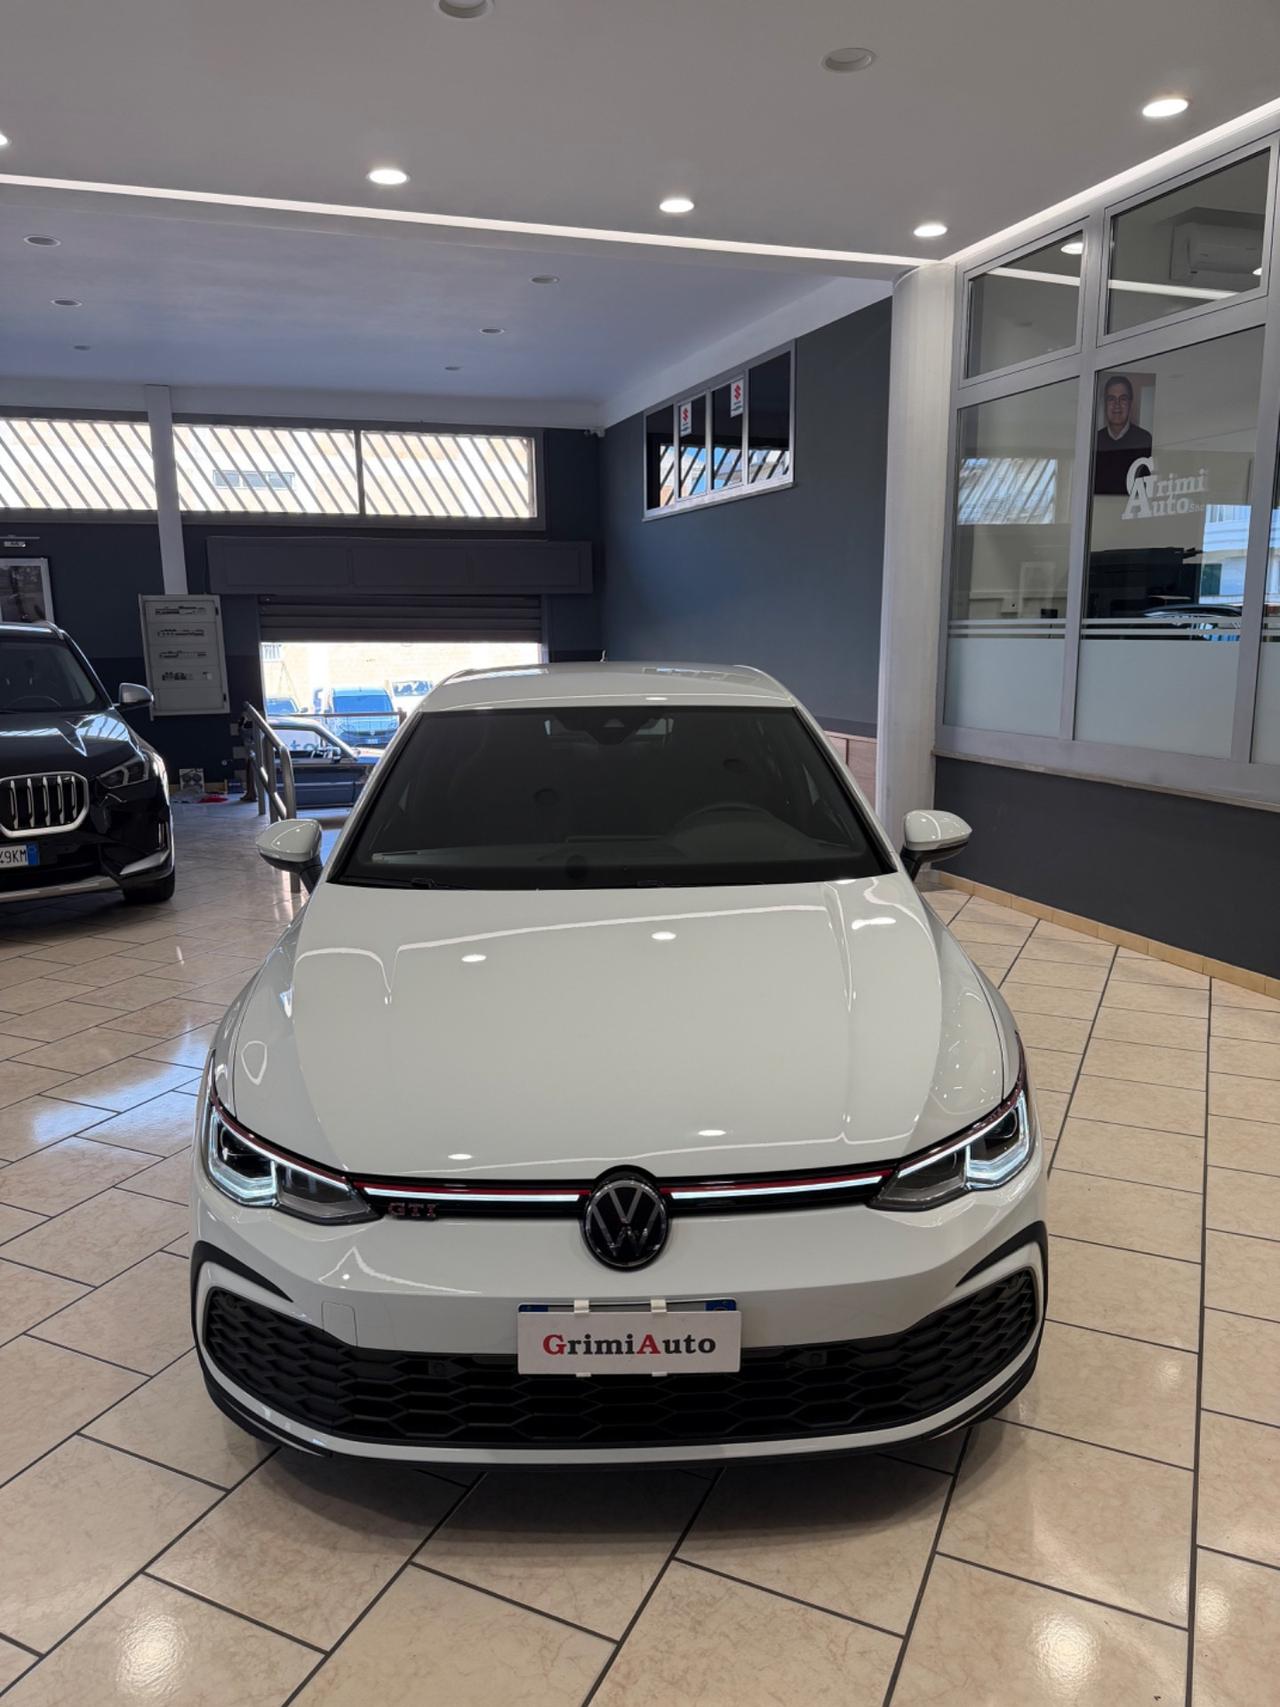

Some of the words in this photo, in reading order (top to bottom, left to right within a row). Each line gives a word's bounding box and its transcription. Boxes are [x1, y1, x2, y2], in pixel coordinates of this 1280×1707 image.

[1126, 456, 1206, 498] Grimi
[1121, 477, 1189, 519] Auto
[388, 1202, 437, 1217] GTI
[542, 1333, 717, 1356] GrimiAuto
